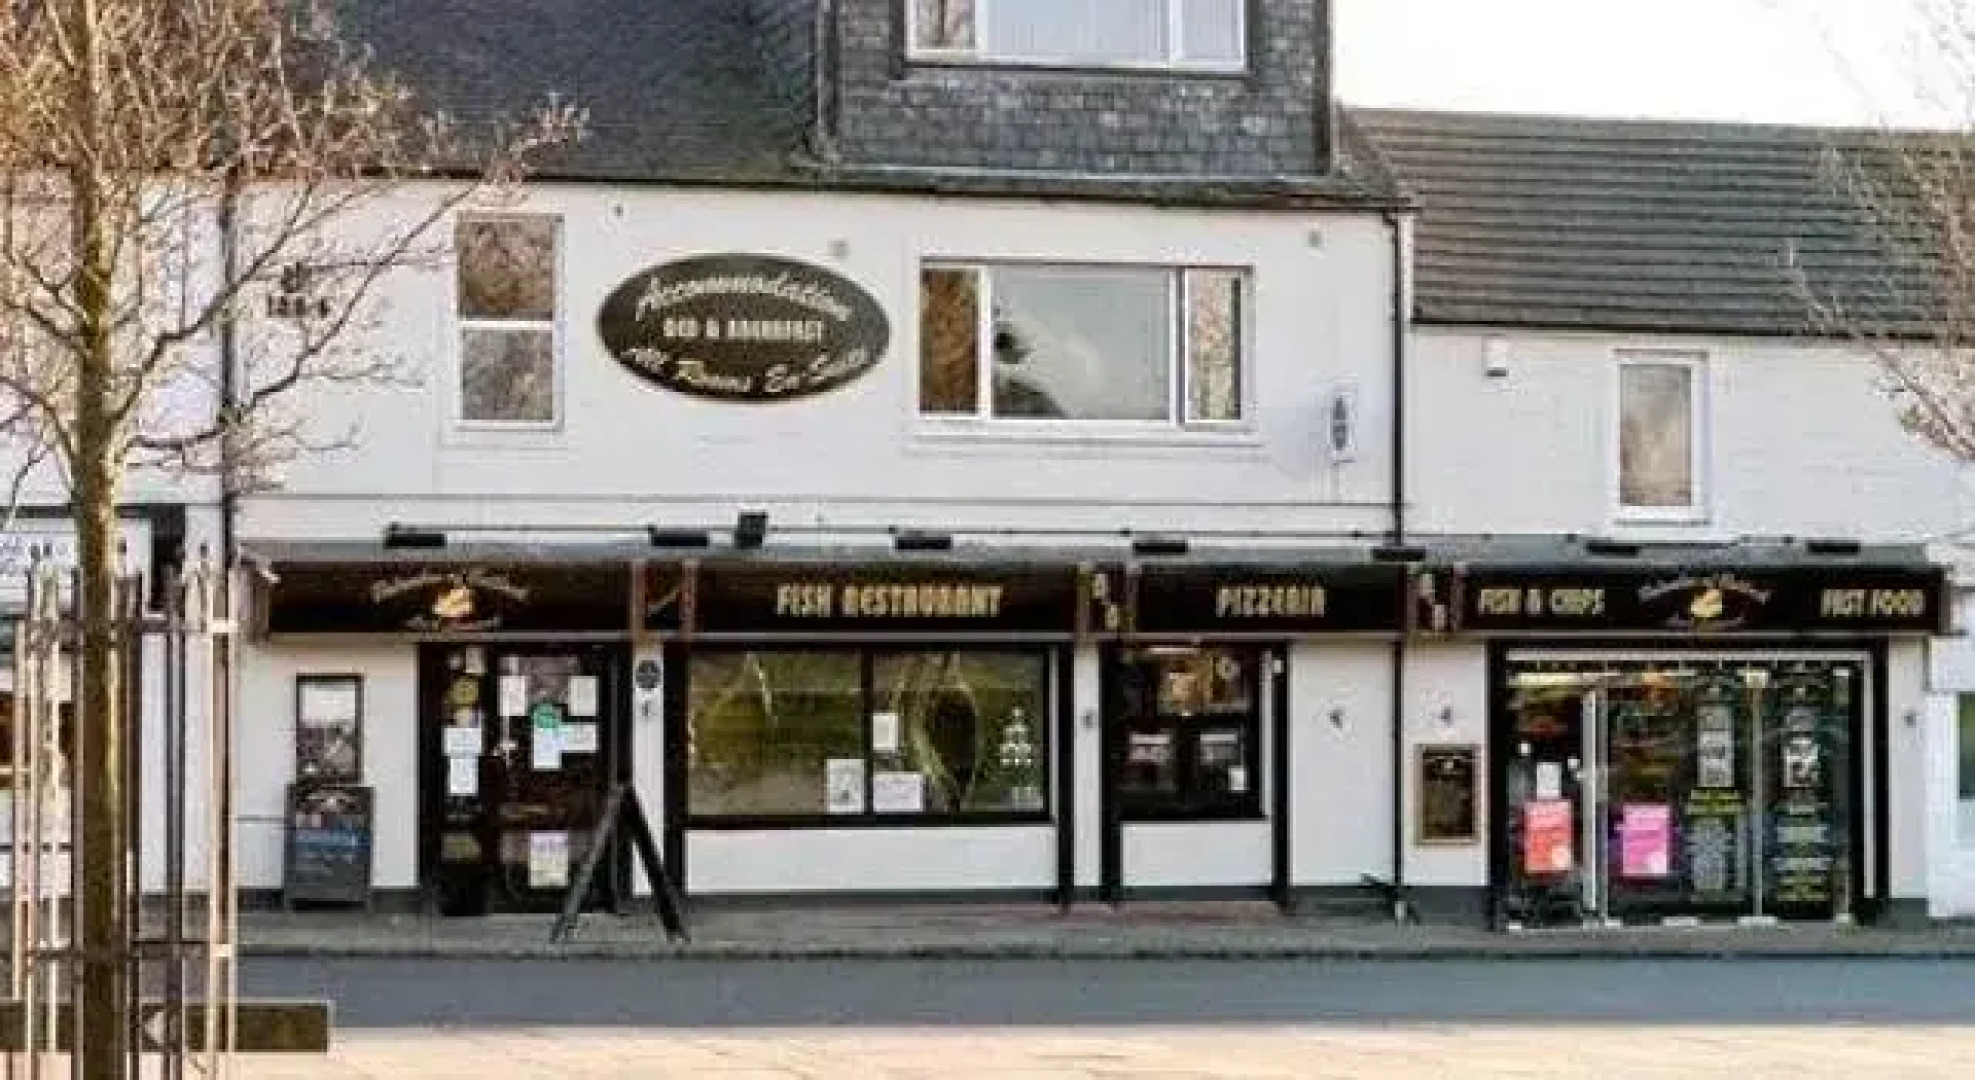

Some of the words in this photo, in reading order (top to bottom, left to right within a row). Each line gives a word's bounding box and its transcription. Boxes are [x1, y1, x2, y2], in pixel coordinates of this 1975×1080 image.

[635, 271, 853, 321] Accommodation
[776, 584, 833, 617] FISH
[841, 584, 1004, 617] RESTAURANT
[1215, 585, 1326, 618] PIZZERIA
[1478, 587, 1522, 616] FISH
[1548, 587, 1606, 617] CHIPS
[1820, 588, 1866, 618] FAST
[1870, 588, 1927, 618] FOOD
